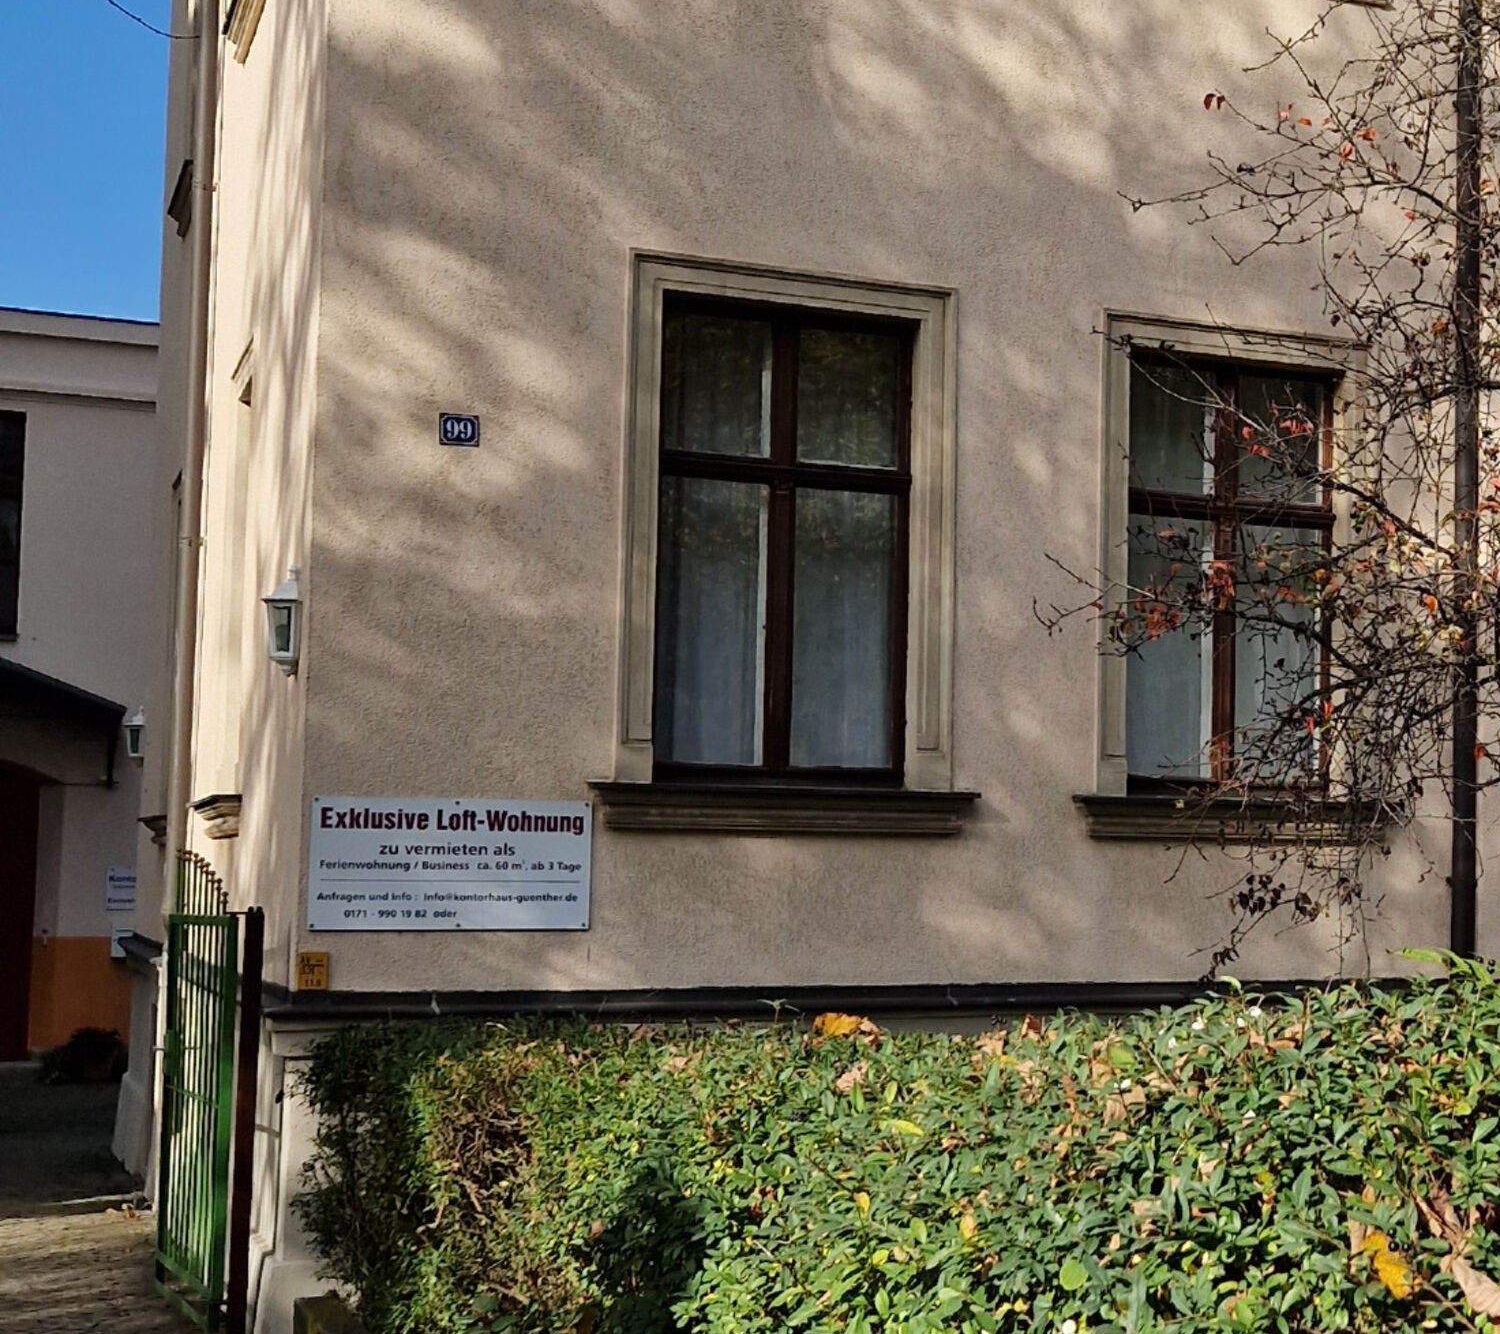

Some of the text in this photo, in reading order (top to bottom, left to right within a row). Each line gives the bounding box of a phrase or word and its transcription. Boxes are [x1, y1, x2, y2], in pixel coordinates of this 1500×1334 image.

[446, 419, 473, 440] 99
[320, 807, 584, 836] Exklusive Loft-Wohnung
[379, 842, 516, 856] zu vermieten als
[319, 859, 411, 872] Ferienwohnung
[421, 860, 470, 870] Business
[477, 861, 492, 870] ca.
[495, 860, 508, 870] 60
[530, 860, 545, 871] ab
[548, 861, 555, 870] 3
[556, 861, 582, 873] Tage
[316, 892, 366, 903] Anfragen
[368, 892, 389, 901] und
[390, 892, 412, 901] Info
[343, 909, 367, 919] 0171
[378, 909, 397, 919] 990
[400, 909, 412, 919] 19
[432, 908, 457, 919] oder
